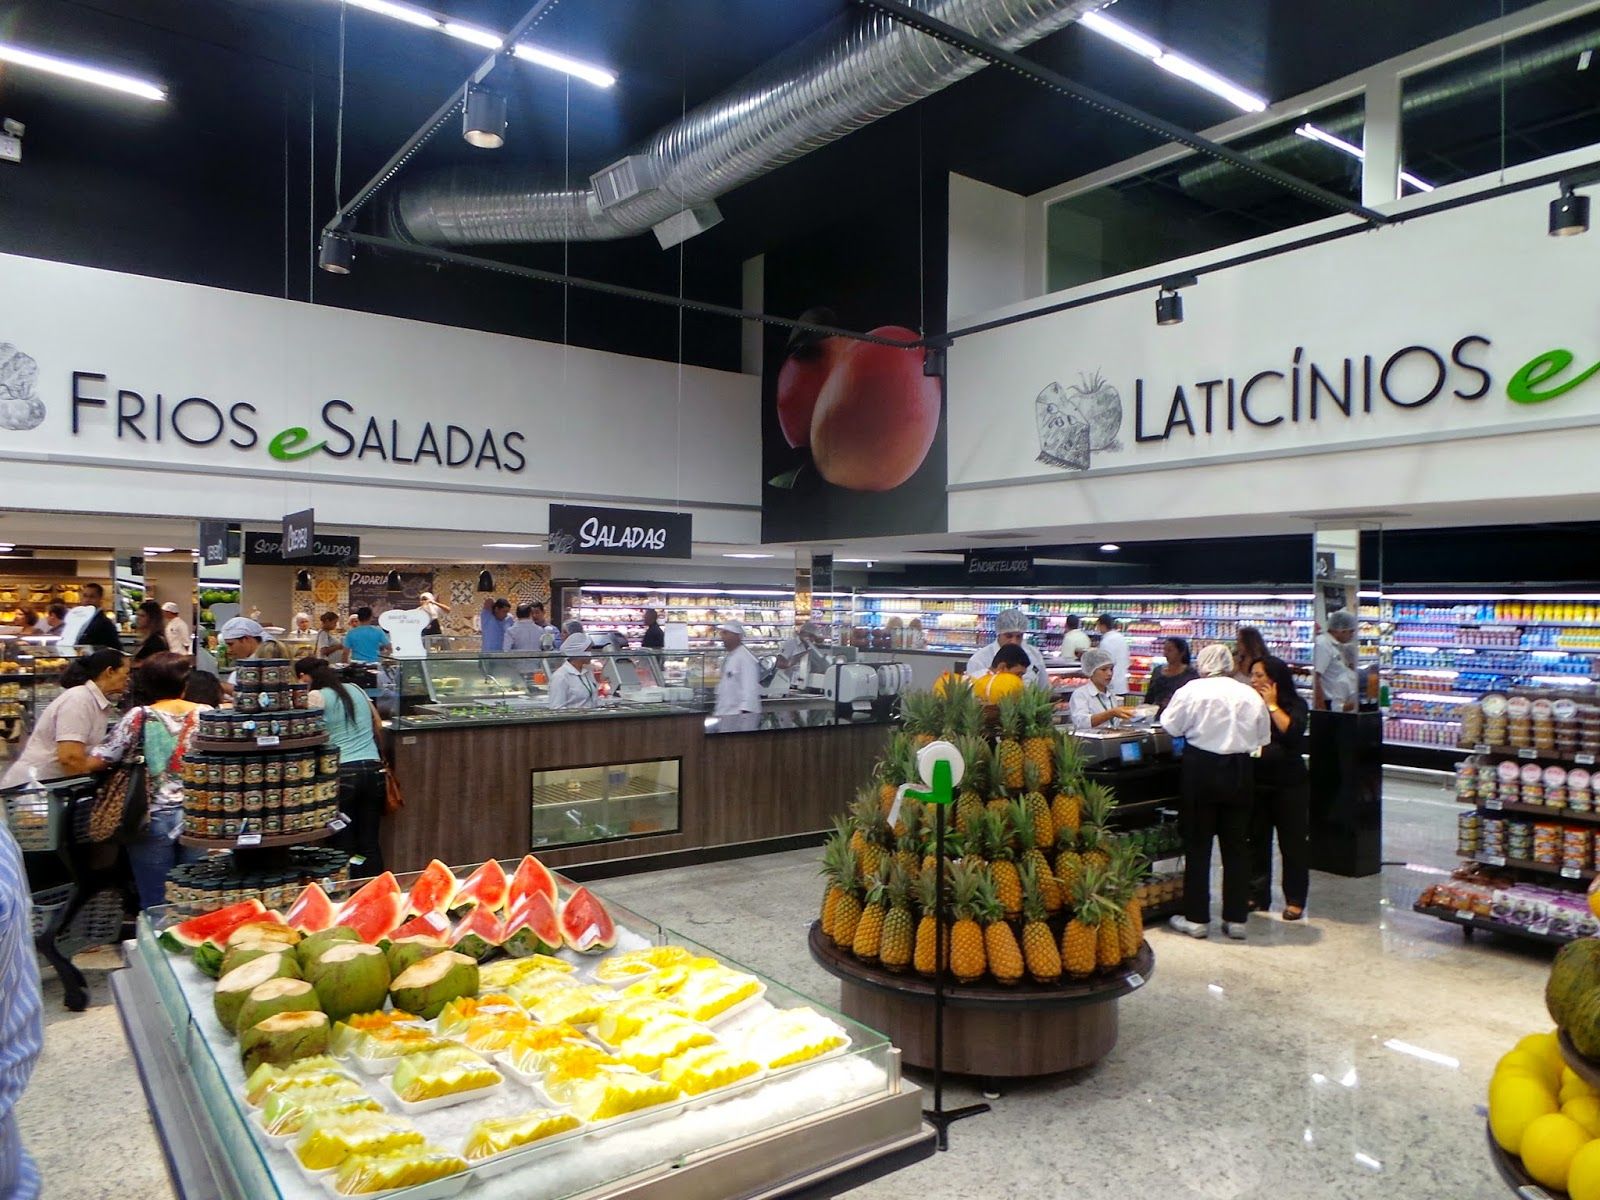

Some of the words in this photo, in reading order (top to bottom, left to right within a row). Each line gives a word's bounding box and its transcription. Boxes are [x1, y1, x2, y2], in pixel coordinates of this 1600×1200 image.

[1134, 334, 1493, 443] LATICÍNIOS
[71, 370, 259, 450] FRIOS
[267, 425, 329, 462] e
[320, 398, 526, 473] SALADAS
[312, 541, 352, 556] CALDOS
[580, 516, 667, 550] SALADAS
[349, 572, 389, 586] PADARIA
